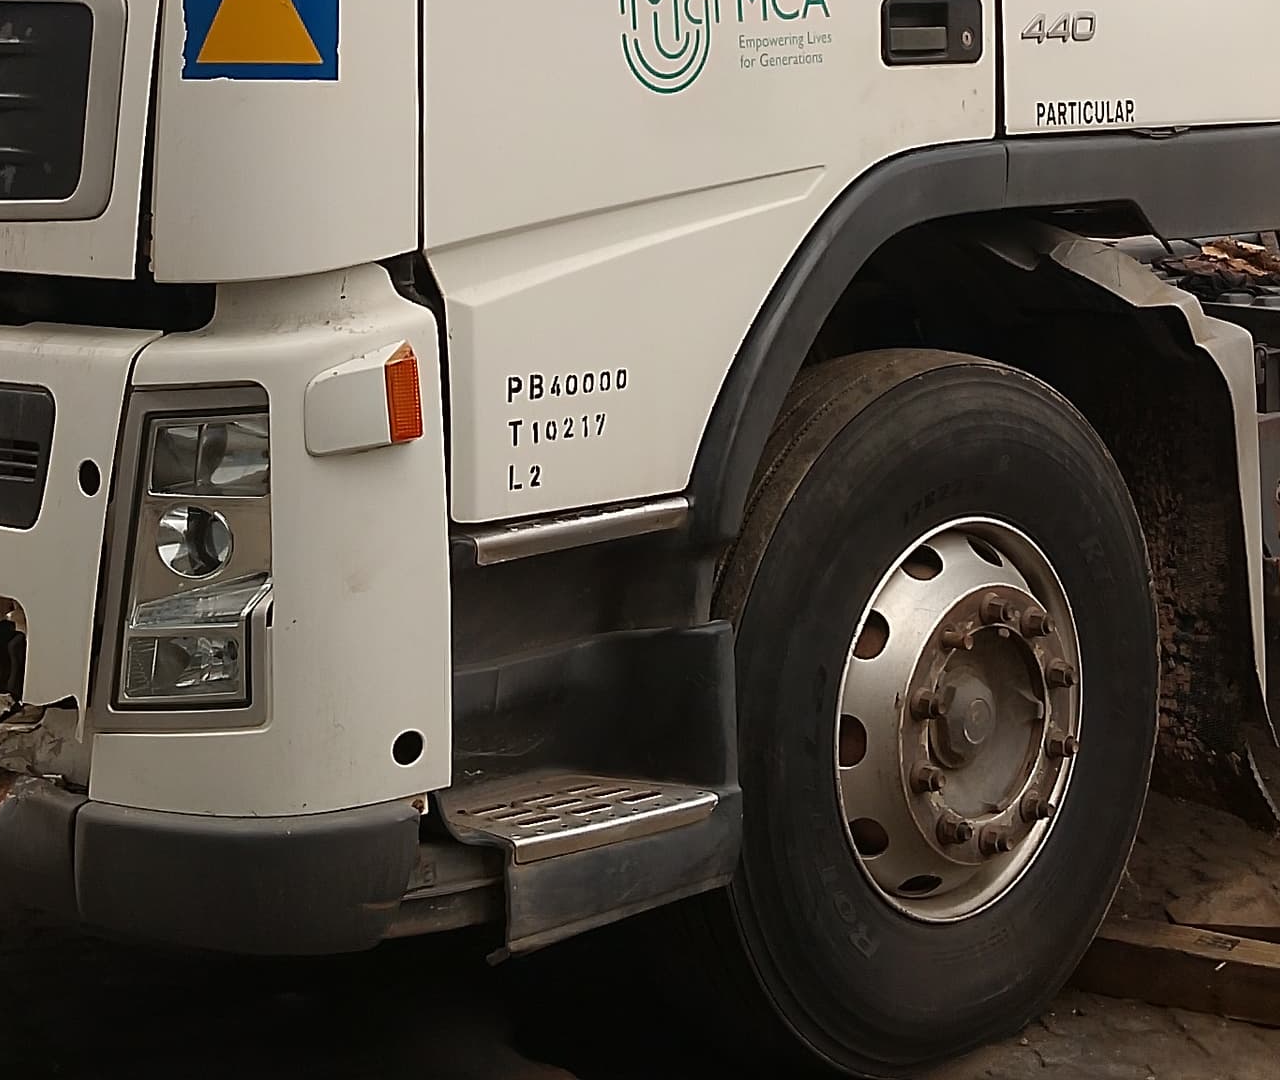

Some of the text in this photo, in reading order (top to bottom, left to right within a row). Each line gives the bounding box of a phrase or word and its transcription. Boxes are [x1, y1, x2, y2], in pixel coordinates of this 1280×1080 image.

[1021, 11, 1097, 44] 440
[738, 31, 832, 51] Empowering Lives
[740, 52, 823, 68] for Generations
[1036, 100, 1135, 125] PARTICULAR
